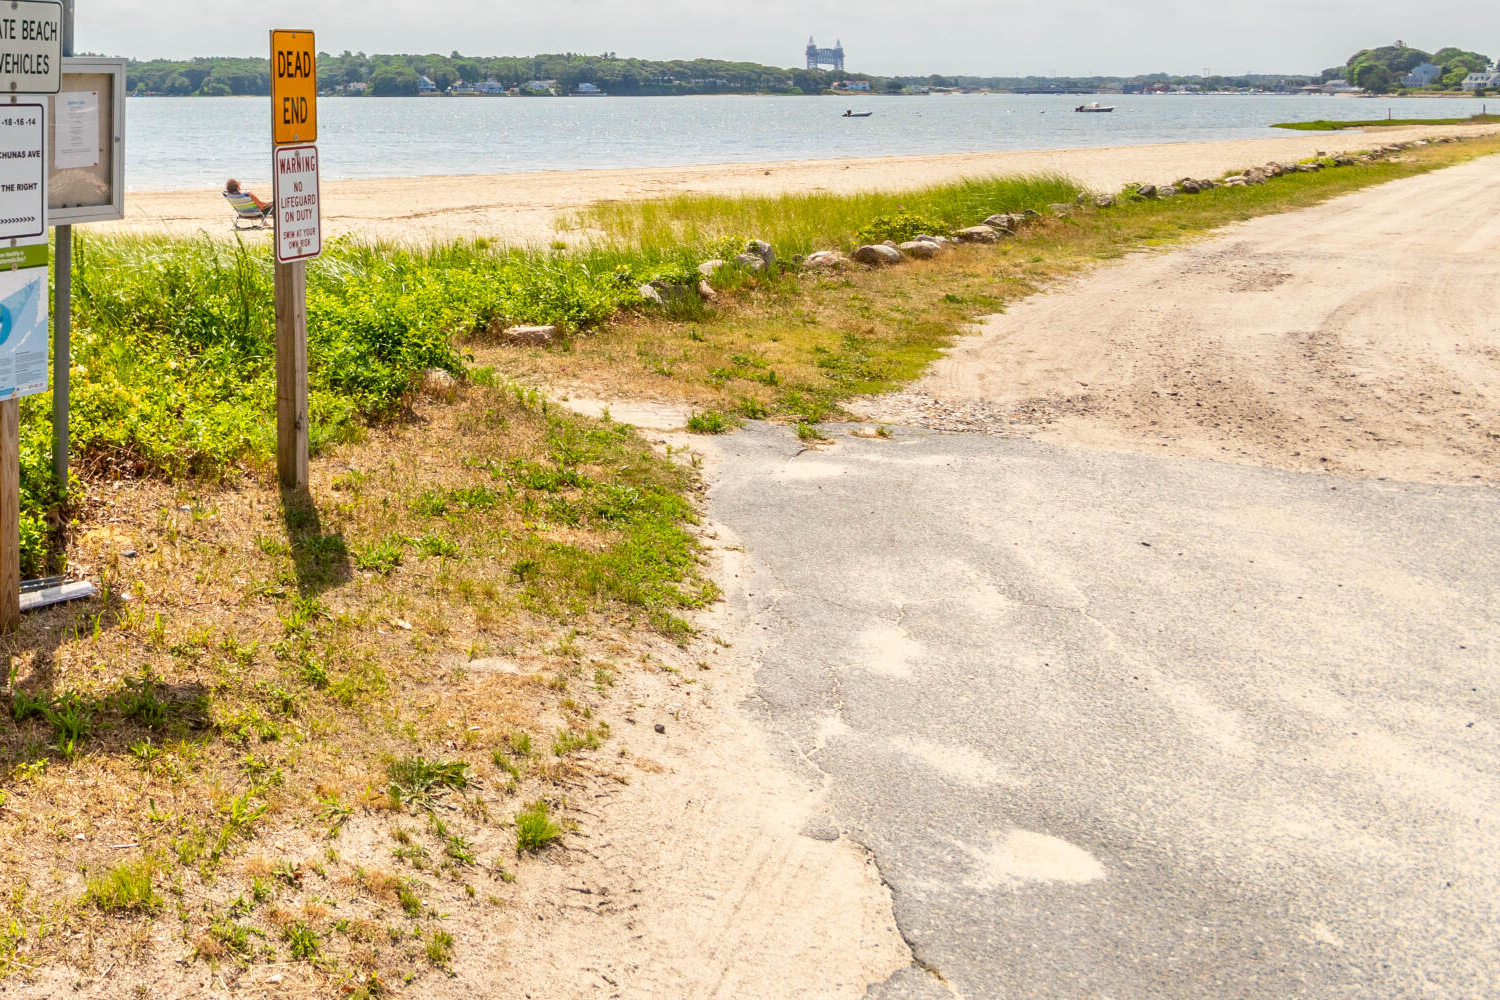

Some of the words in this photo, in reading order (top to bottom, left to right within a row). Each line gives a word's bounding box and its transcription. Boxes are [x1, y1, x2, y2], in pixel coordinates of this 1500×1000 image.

[22, 20, 57, 41] BEACH
[278, 51, 311, 78] DEAD
[284, 97, 308, 124] END
[279, 156, 315, 174] WARNING
[17, 183, 37, 191] RIGHT
[294, 181, 302, 192] NO
[281, 194, 315, 208] LIFEGUARD
[285, 212, 294, 222] ON
[297, 209, 312, 221] DUTY
[303, 227, 315, 236] YOUR
